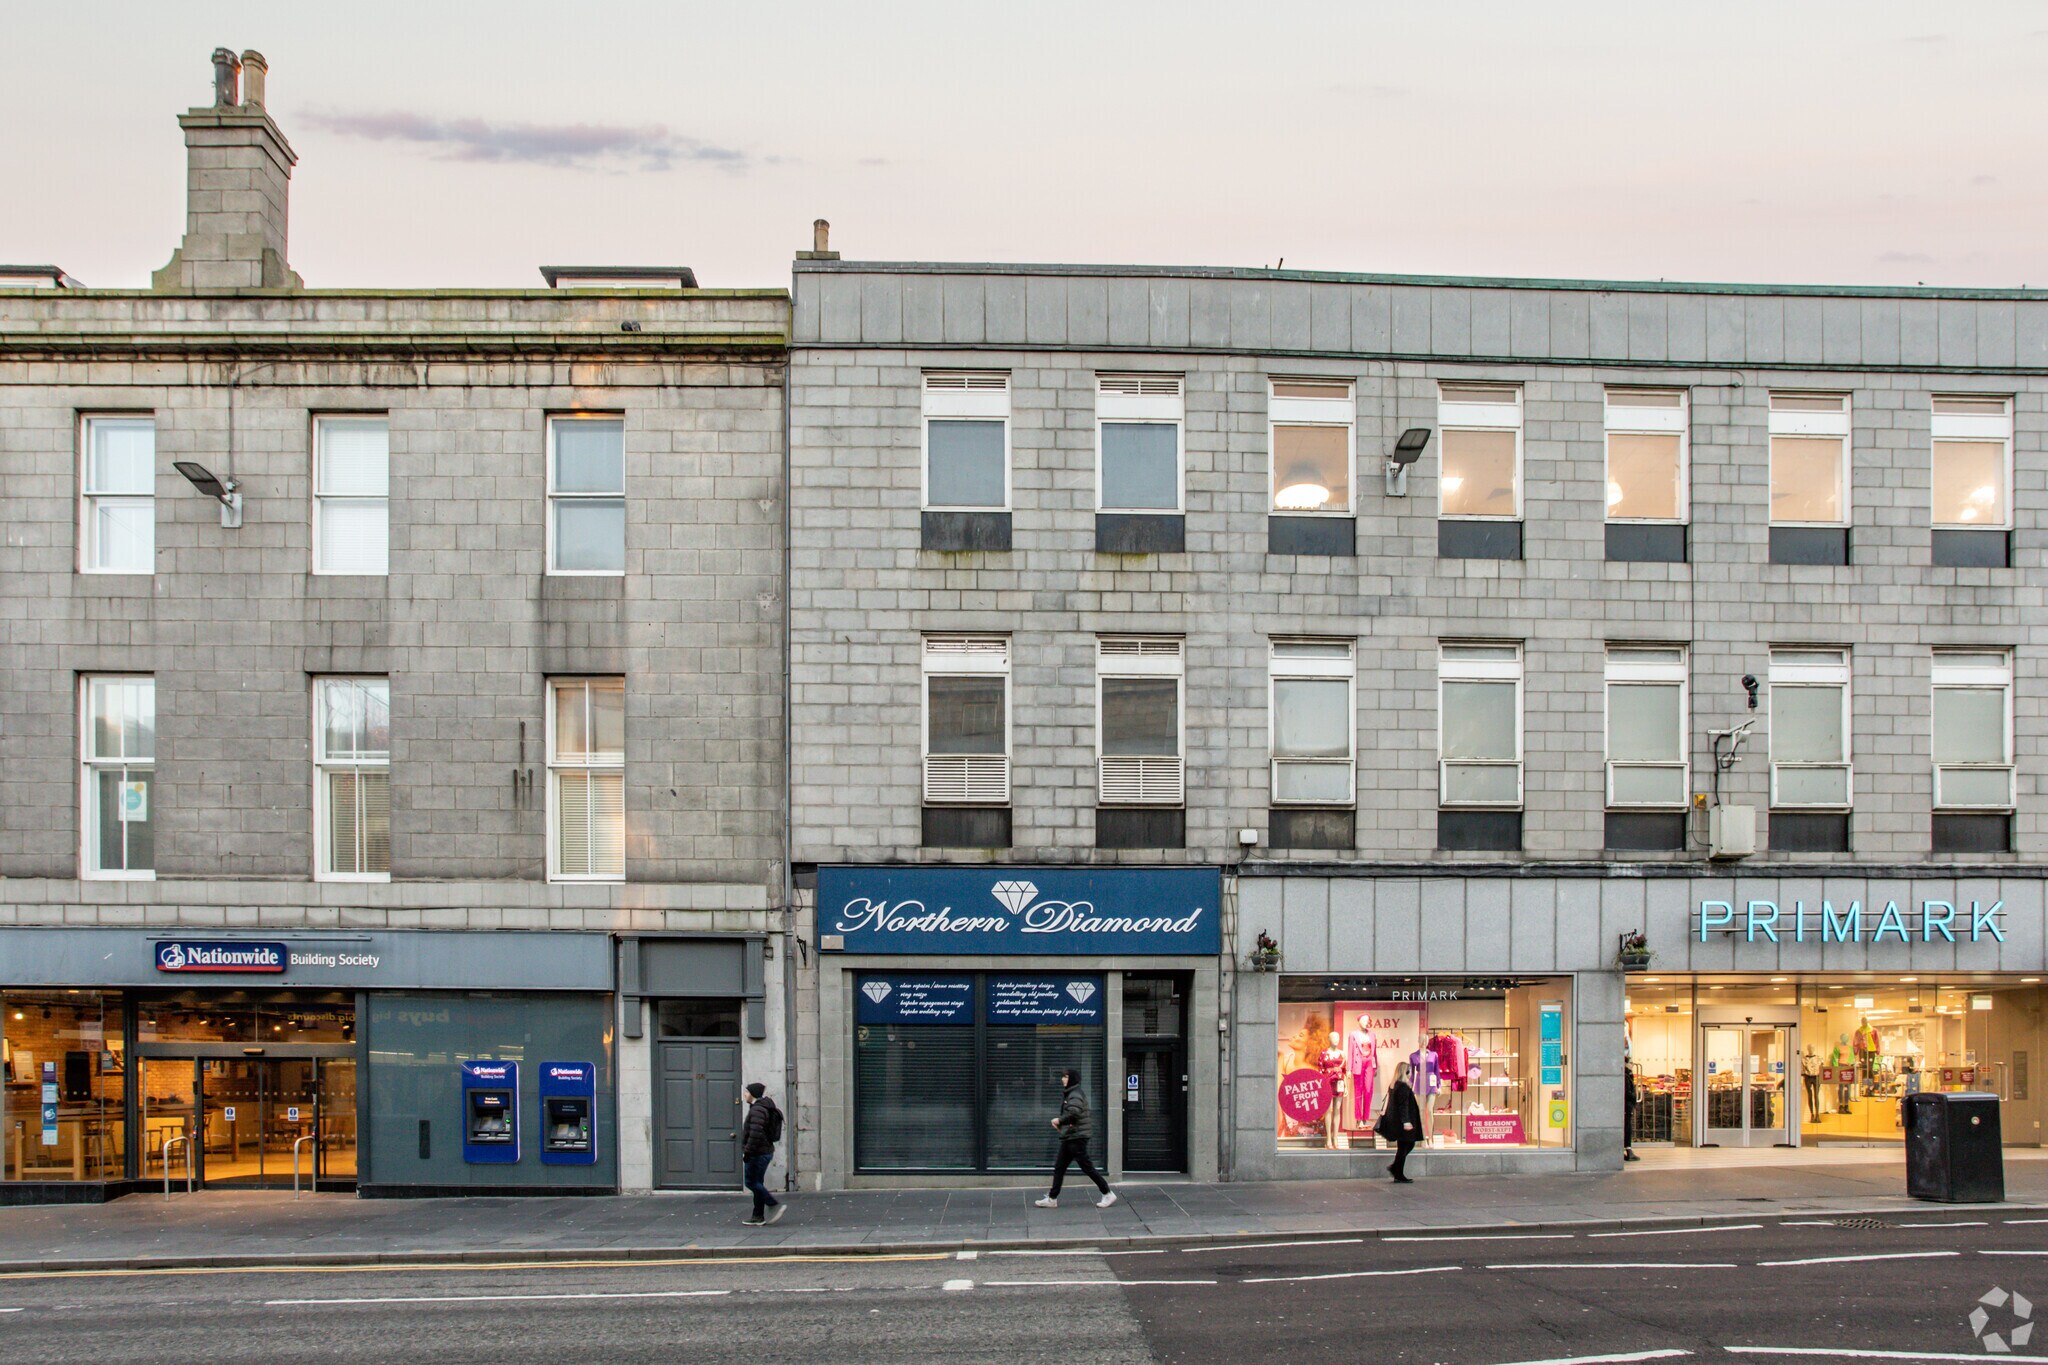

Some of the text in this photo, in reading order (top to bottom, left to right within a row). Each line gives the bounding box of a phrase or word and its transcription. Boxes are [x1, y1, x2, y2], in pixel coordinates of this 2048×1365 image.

[835, 897, 1203, 933] Northern Diamond
[1700, 900, 2005, 943] PRIMARK
[187, 947, 279, 965] Nationwide
[290, 953, 380, 968] Building Society
[1392, 990, 1458, 1001] PRIMARK
[918, 1000, 950, 1008] engagement
[918, 1008, 941, 1017] wedding
[480, 1066, 506, 1074] Nationwide
[1284, 1079, 1323, 1095] PARTY
[1293, 1090, 1319, 1101] FROM
[1295, 1098, 1319, 1112] £11
